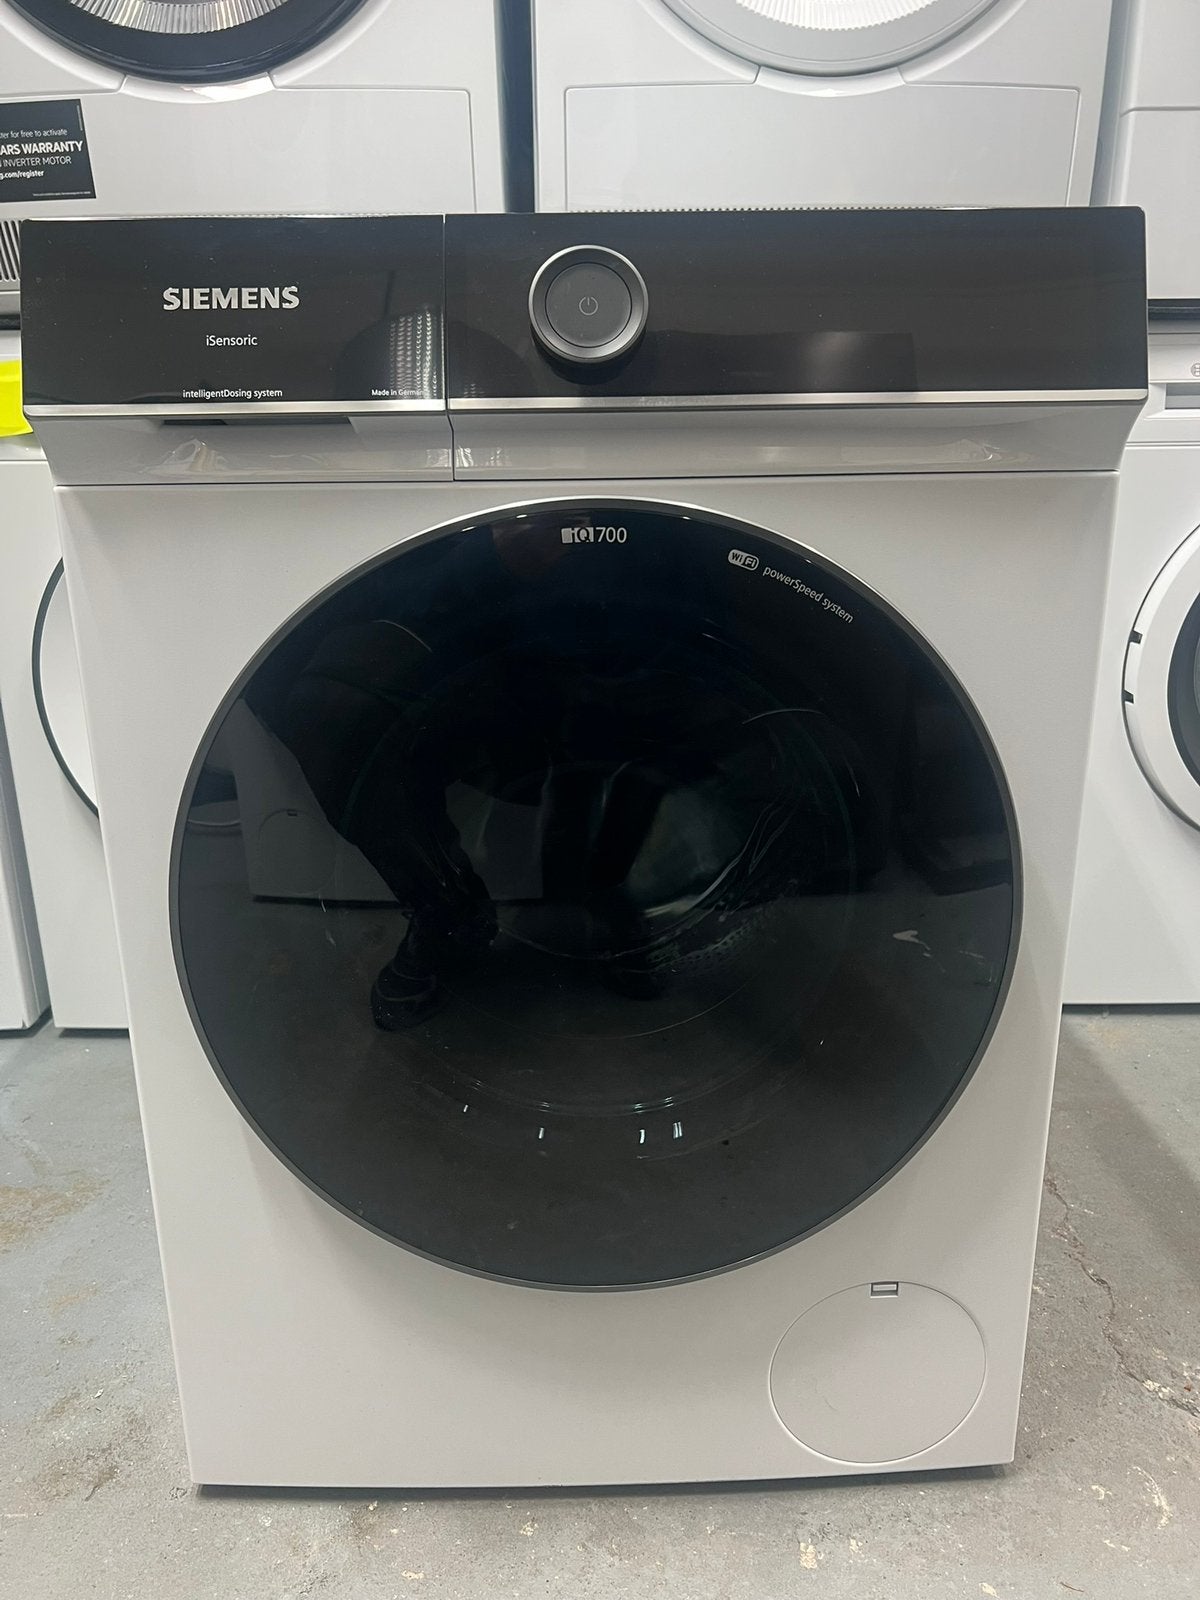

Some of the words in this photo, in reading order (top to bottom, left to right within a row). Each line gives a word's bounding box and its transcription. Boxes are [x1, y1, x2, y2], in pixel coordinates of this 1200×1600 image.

[10, 130, 19, 138] for
[21, 129, 33, 138] free
[34, 129, 42, 137] to
[43, 128, 68, 136] activate
[21, 141, 83, 154] WARRANTY
[3, 157, 41, 167] INVERTER
[42, 155, 72, 165] MOTOR
[163, 286, 300, 311] SIEMENS
[206, 334, 258, 346] iSensoric
[182, 388, 252, 399] intelligentDosing
[253, 389, 283, 399] system
[398, 389, 430, 397] German
[762, 566, 824, 602] powerSpeed
[821, 598, 854, 623] system
